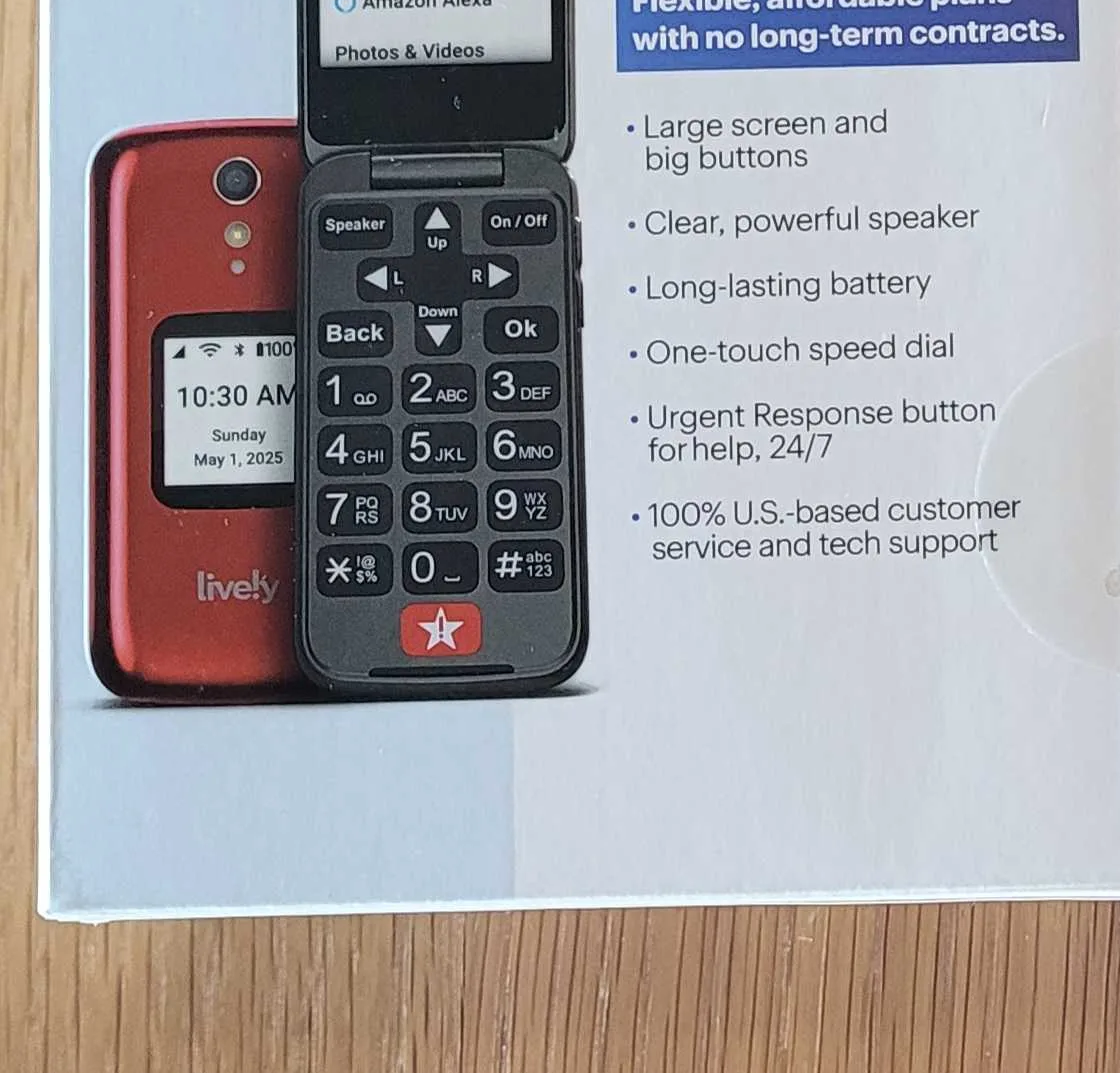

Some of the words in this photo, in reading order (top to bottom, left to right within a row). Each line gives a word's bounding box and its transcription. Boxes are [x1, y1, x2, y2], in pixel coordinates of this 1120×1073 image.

[633, 25, 699, 51] with
[705, 27, 745, 49] no
[750, 23, 903, 52] long-term
[909, 18, 1065, 45] contracts.
[335, 45, 399, 62] Photos
[405, 44, 417, 59] &
[423, 43, 485, 59] Videos
[644, 115, 724, 144] Large
[731, 114, 826, 137] screen
[834, 109, 888, 134] and
[645, 146, 689, 176] big
[700, 145, 808, 170] buttons
[325, 217, 386, 234] Speaker
[490, 215, 513, 229] On
[524, 213, 548, 227] Off
[644, 210, 725, 238] Clear,
[734, 206, 860, 238] powerful
[868, 204, 980, 234] speaker
[428, 235, 448, 251] Up
[394, 271, 404, 285] L
[472, 269, 482, 283] R
[646, 271, 821, 304] Long-lasting
[831, 271, 931, 299] battery
[418, 305, 458, 318] Down
[326, 324, 384, 343] Back
[504, 319, 538, 338] Ok
[647, 337, 800, 365] One-touch
[808, 335, 896, 366] speed
[905, 333, 955, 359] dial
[178, 384, 248, 408] 10:30
[257, 384, 296, 406] AM
[325, 375, 341, 406] 1
[409, 373, 433, 403] 2
[436, 388, 468, 402] ABC
[492, 370, 515, 401] 3
[520, 387, 552, 401] DEF
[648, 404, 745, 433] Urgent
[754, 402, 893, 432] Response
[902, 399, 997, 424] button
[212, 428, 267, 443] Sunday
[325, 434, 349, 465] 4
[353, 450, 384, 464] GHI
[409, 432, 431, 462] 5
[435, 448, 466, 462] JKL
[493, 429, 517, 461] 6
[519, 445, 554, 460] MNO
[649, 437, 687, 462] for
[693, 437, 762, 464] help,
[769, 433, 833, 461] 24/7
[194, 453, 225, 468] May
[231, 453, 242, 467] 1,
[246, 452, 283, 466] 2025
[325, 493, 348, 525] 7
[356, 497, 379, 511] PQ
[355, 510, 379, 524] RS
[409, 491, 433, 522] 8
[435, 507, 468, 521] TUV
[494, 489, 518, 520] 9
[524, 493, 547, 506] WX
[525, 506, 547, 520] YZ
[648, 501, 726, 528] 100%
[733, 498, 881, 525] U.S.-based
[887, 495, 1022, 522] customer
[652, 535, 751, 560] service
[758, 532, 812, 558] and
[819, 531, 881, 556] tech
[889, 528, 999, 558] support
[356, 570, 378, 584] $%
[411, 551, 435, 583] 0
[495, 551, 523, 579] #
[525, 550, 552, 564] abc
[528, 564, 552, 578] 123
